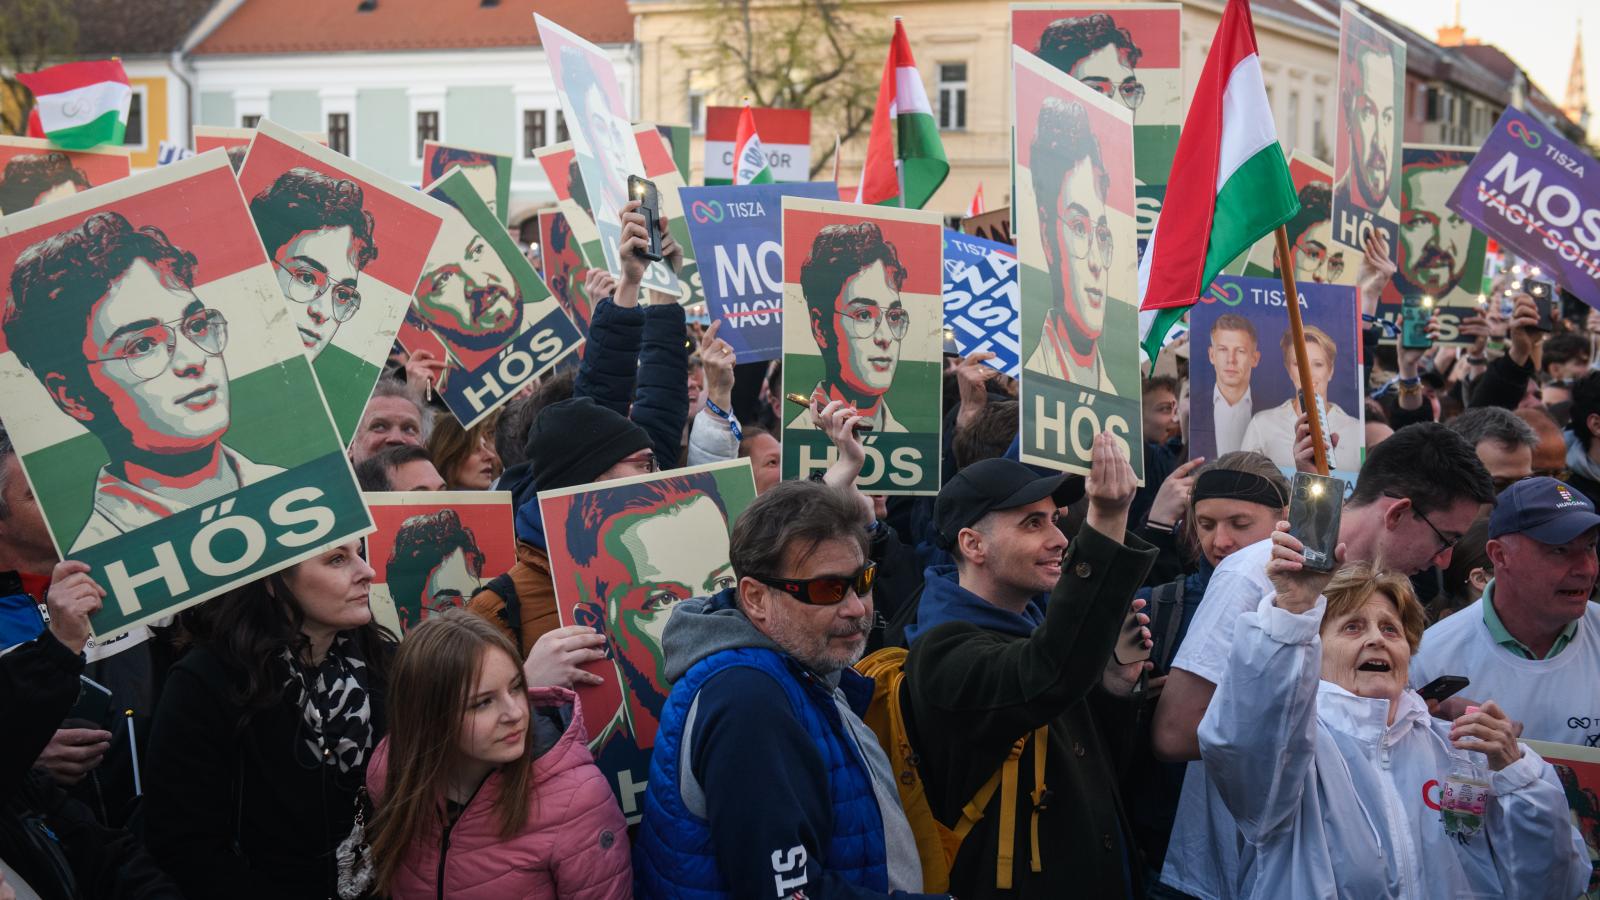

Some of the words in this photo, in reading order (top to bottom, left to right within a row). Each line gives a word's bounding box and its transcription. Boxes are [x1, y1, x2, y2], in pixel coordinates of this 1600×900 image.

[1545, 144, 1585, 178] TISZA
[726, 202, 766, 219] TISZA
[1477, 181, 1545, 234] VAGY
[1542, 229, 1600, 280] SOH
[952, 239, 993, 258] TISZ
[722, 298, 782, 329] VAGY
[462, 328, 563, 413] HŐS
[1035, 391, 1131, 465] HŐS
[800, 435, 923, 486] HŐS
[103, 486, 336, 616] HŐS
